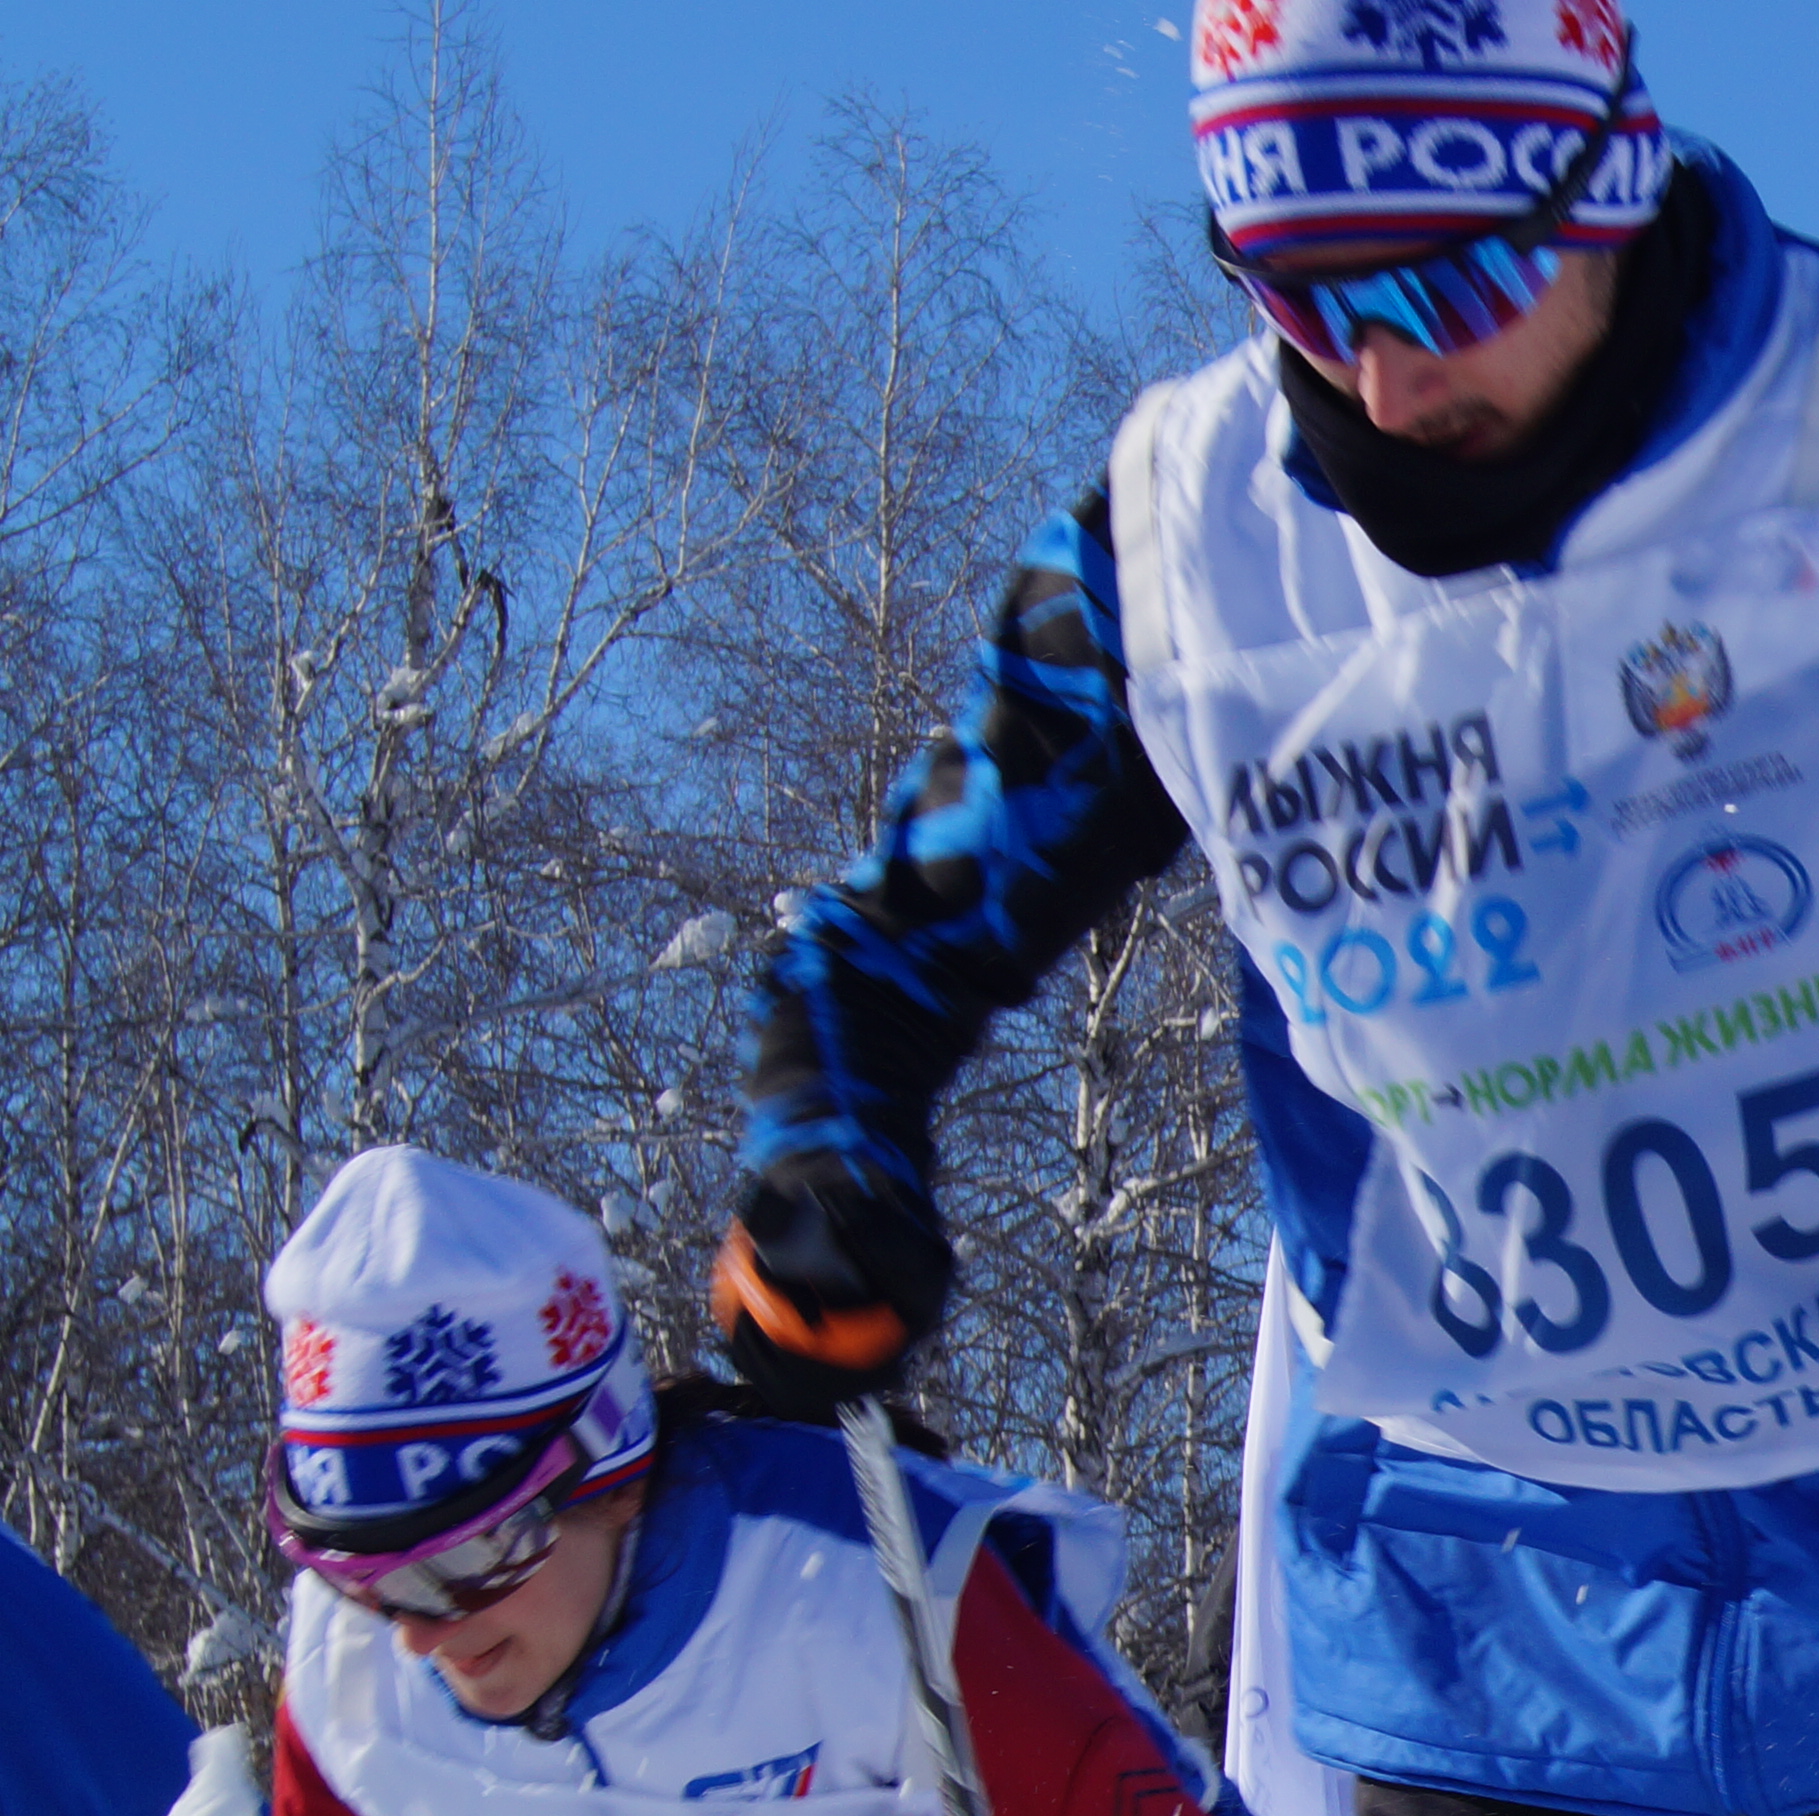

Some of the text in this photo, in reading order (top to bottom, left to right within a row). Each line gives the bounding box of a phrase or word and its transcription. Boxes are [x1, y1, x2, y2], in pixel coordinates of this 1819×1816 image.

[1226, 708, 1501, 838] ЛЫЖНЯ
[1236, 797, 1523, 920] РОССИИ
[1273, 895, 1541, 1027] 2022
[1461, 1029, 1658, 1117] НОРМА
